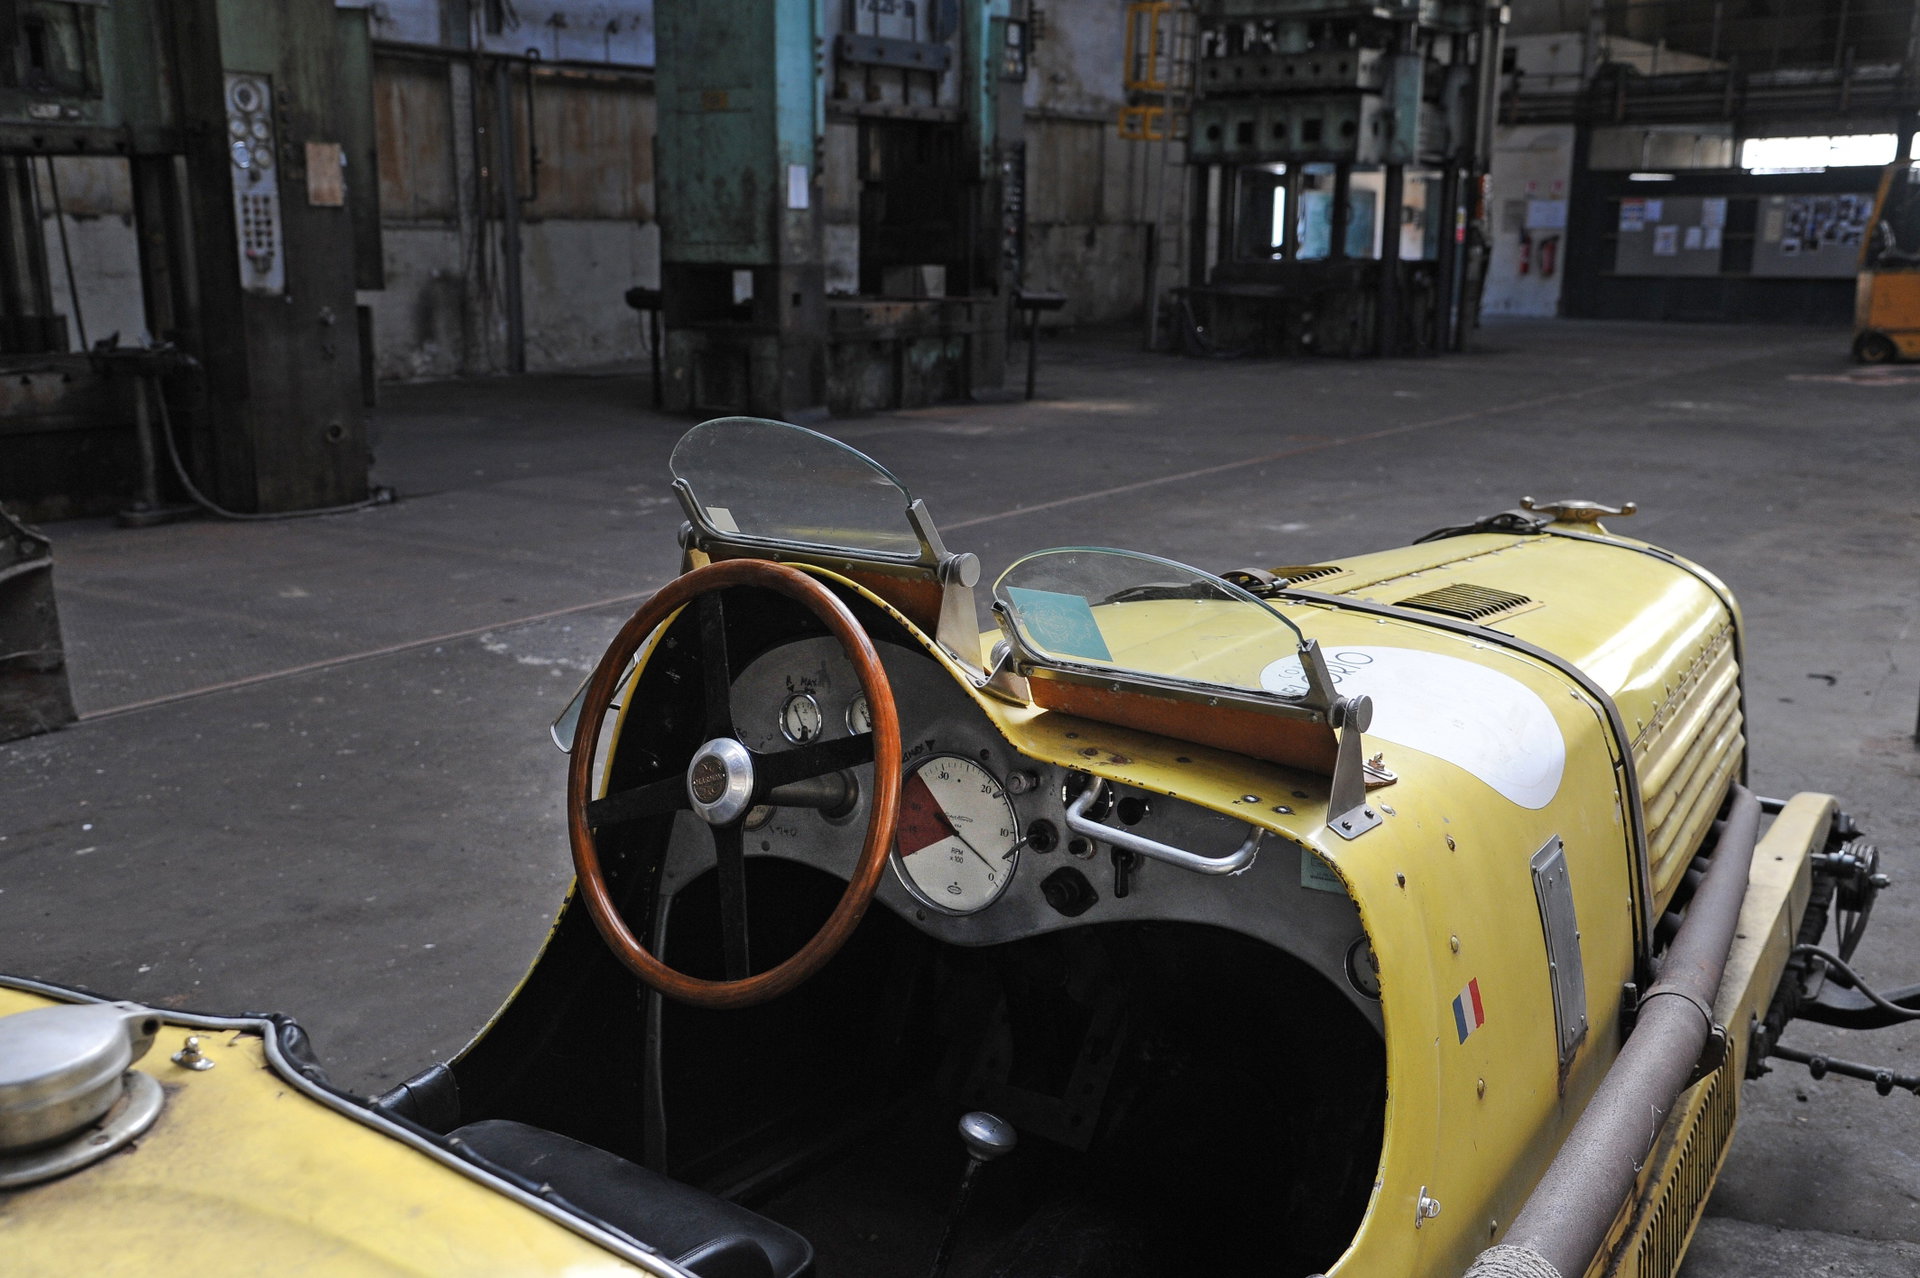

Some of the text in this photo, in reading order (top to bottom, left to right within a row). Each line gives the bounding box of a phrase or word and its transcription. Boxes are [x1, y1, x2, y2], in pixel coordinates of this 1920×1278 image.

[938, 771, 949, 780] 30
[981, 784, 992, 794] 20
[1000, 828, 1009, 837] 10
[951, 847, 964, 855] RPM
[954, 856, 964, 864] 100
[988, 873, 995, 882] 0
